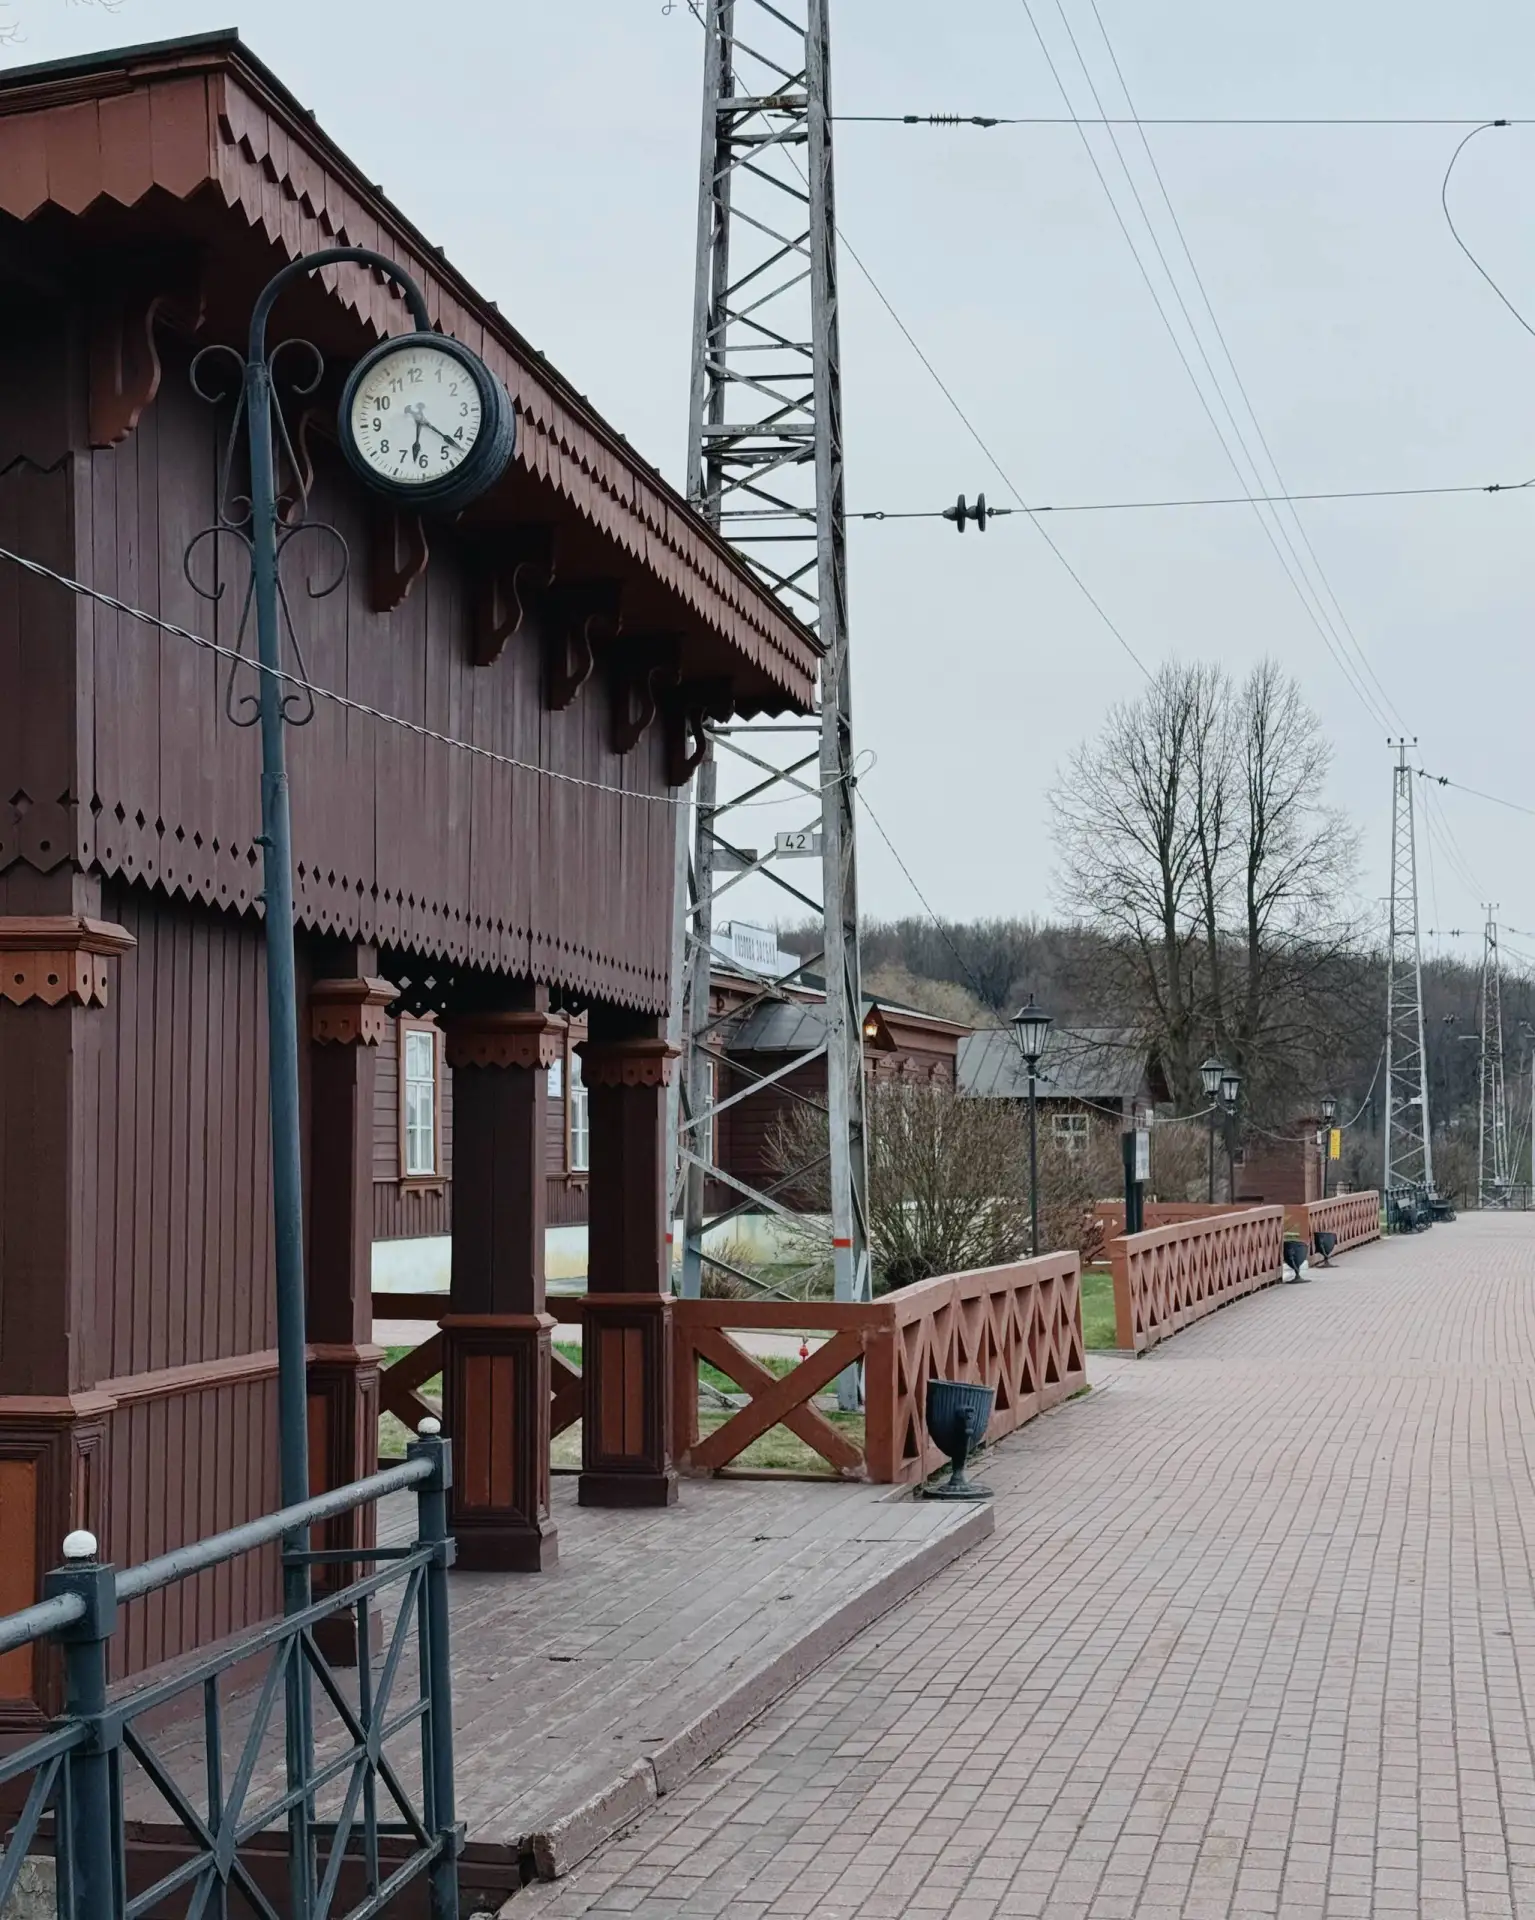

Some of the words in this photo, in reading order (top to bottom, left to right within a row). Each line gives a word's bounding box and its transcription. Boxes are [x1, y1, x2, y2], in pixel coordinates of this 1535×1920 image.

[407, 368, 424, 383] 12
[434, 368, 442, 383] 1
[389, 377, 404, 393] 11
[449, 382, 458, 397] 2
[373, 396, 390, 411] 10
[459, 402, 468, 417] 3
[372, 418, 382, 432] 9
[453, 426, 463, 441] 4
[380, 440, 390, 454] 8
[440, 445, 450, 460] 5
[399, 450, 408, 464] 7
[418, 454, 429, 469] 6
[785, 834, 806, 850] 42
